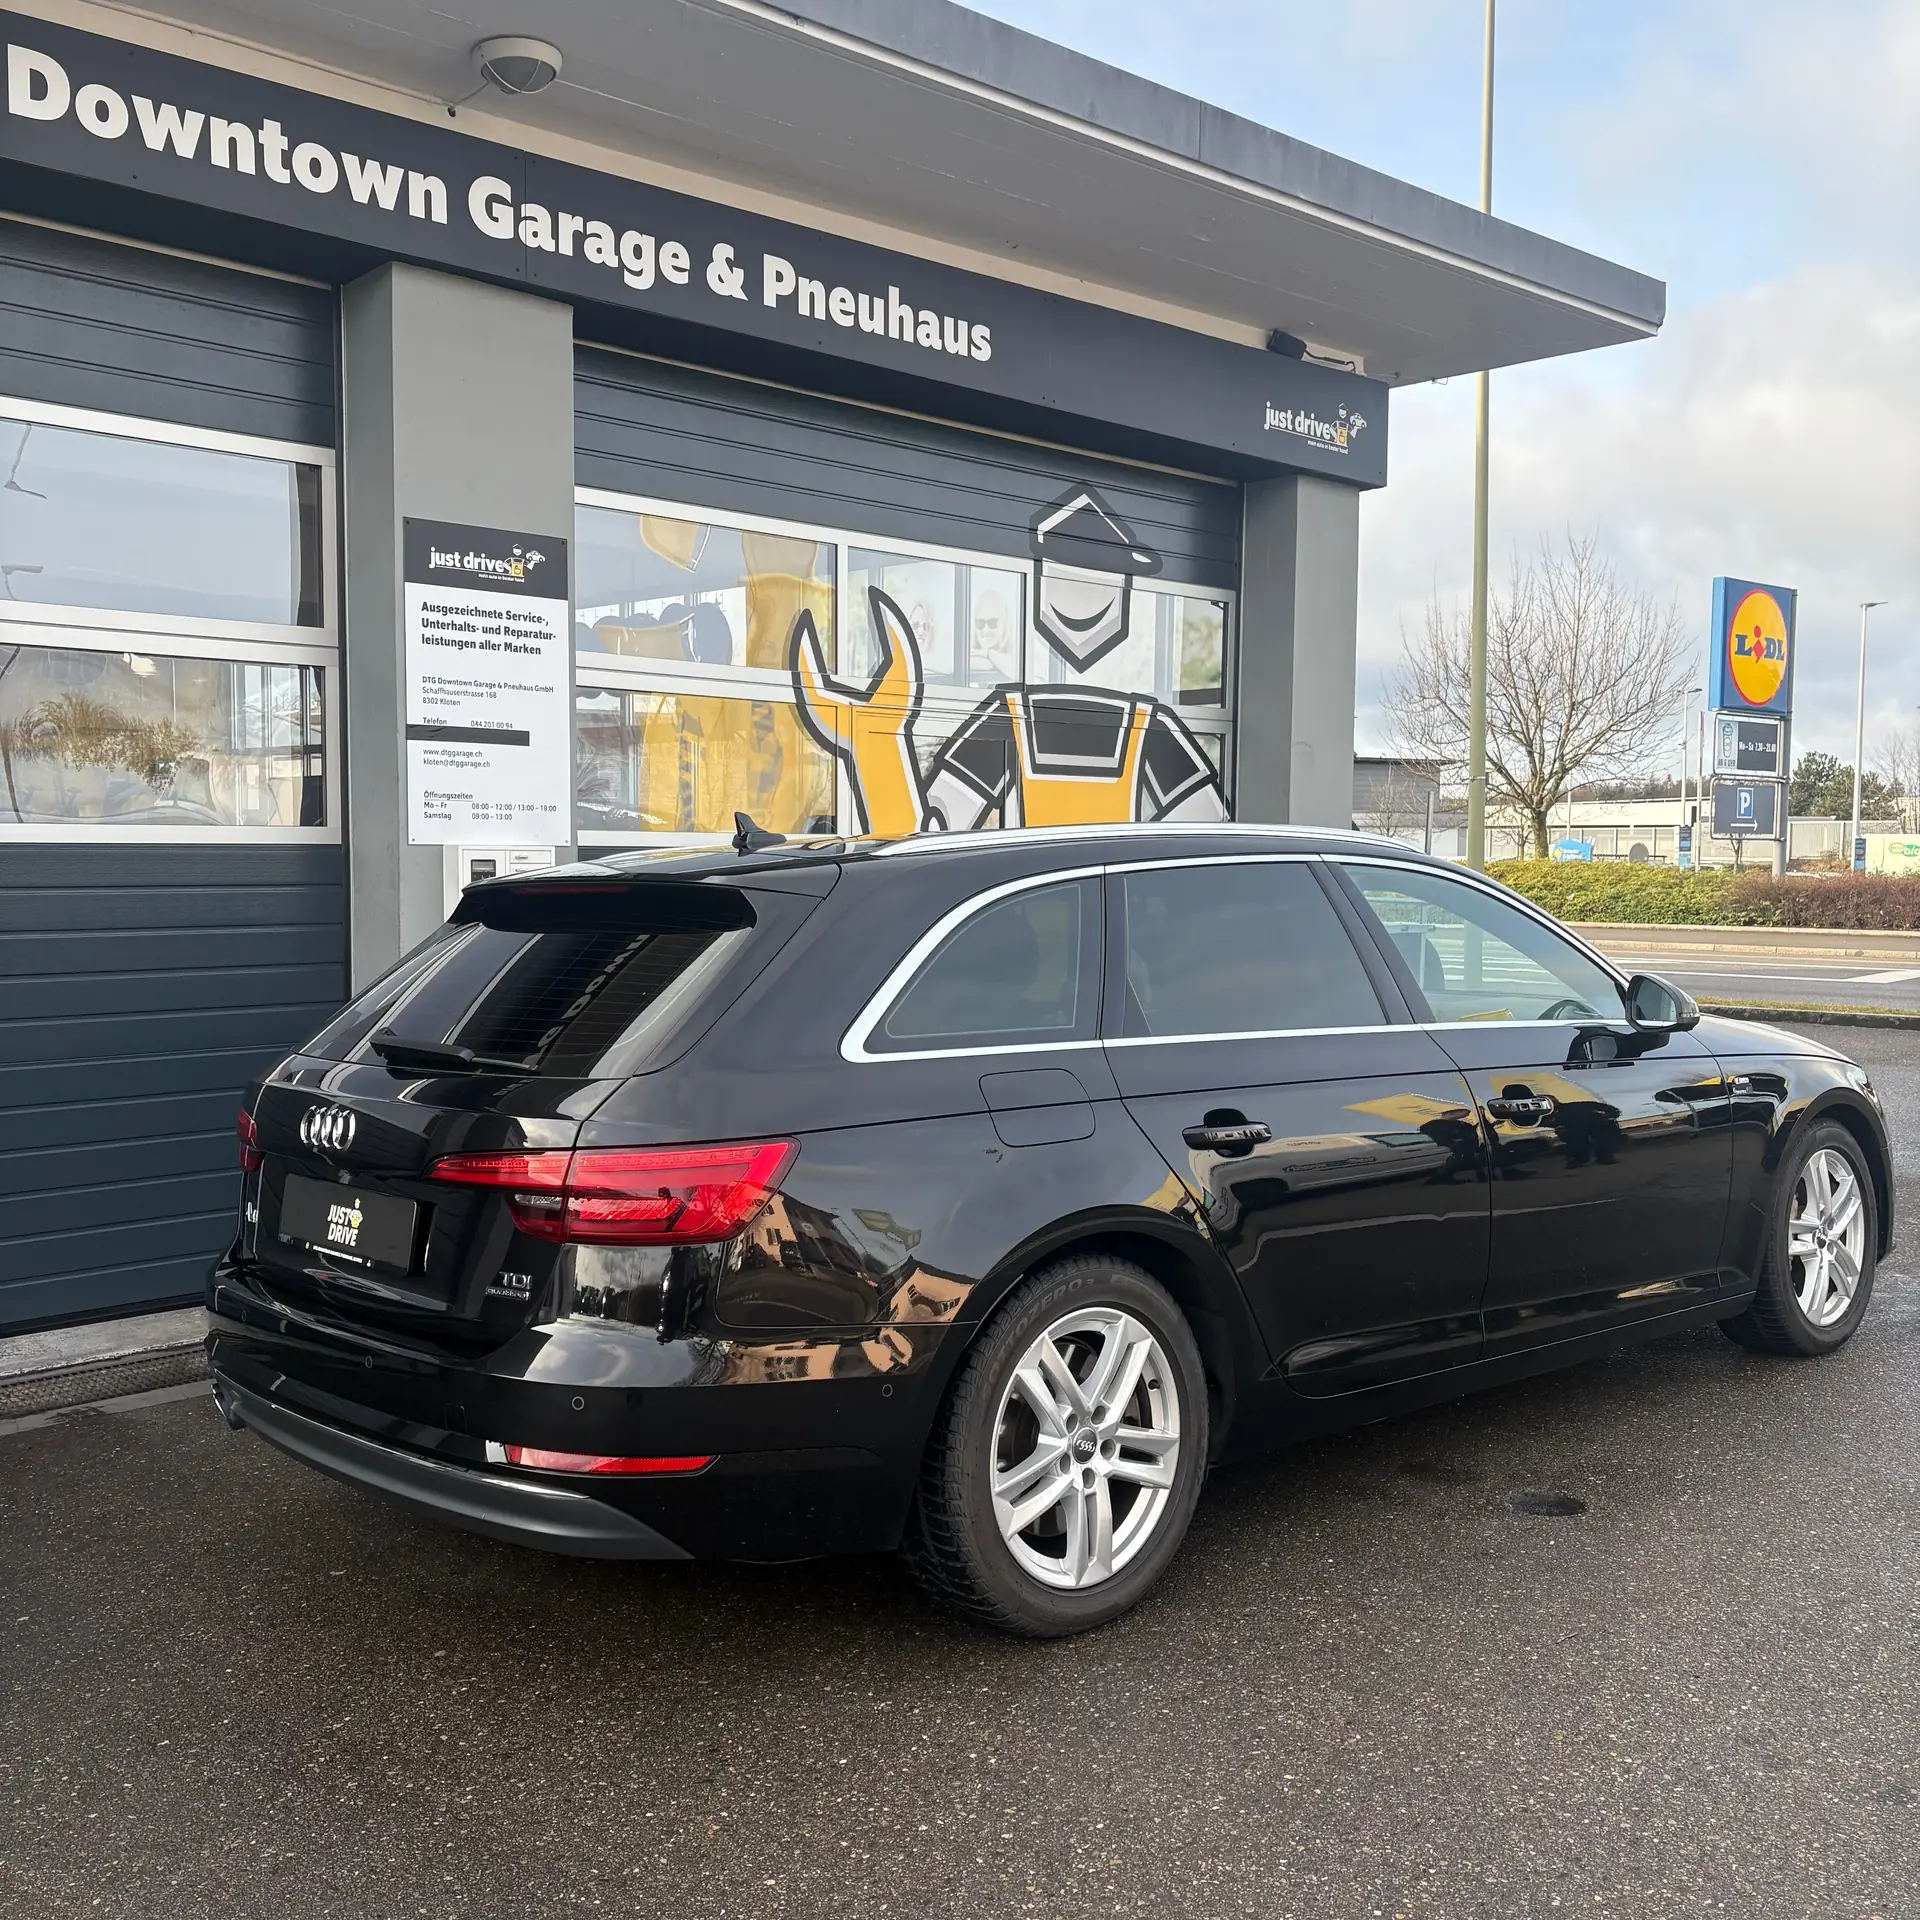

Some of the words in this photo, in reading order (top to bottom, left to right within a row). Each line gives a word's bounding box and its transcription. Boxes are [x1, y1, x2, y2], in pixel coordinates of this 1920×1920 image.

[7, 43, 448, 225] Downtown
[468, 176, 691, 290] Garage
[706, 242, 748, 301] &
[763, 253, 993, 362] Pneuhaus
[1264, 401, 1293, 431] just
[1295, 410, 1331, 440] drive
[429, 546, 461, 569] just
[463, 552, 504, 573] drive
[421, 601, 504, 620] Ausgezeichnete
[505, 610, 549, 626] Service-,
[421, 617, 480, 633] Unterhalts-
[482, 625, 501, 636] und
[503, 626, 557, 640] Reparatur-
[421, 633, 477, 650] leistungen
[478, 640, 502, 651] aller
[504, 642, 541, 655] Marken
[422, 676, 437, 684] DTG
[437, 677, 473, 687] Downtown
[473, 680, 497, 690] Garage
[497, 681, 503, 689] &
[503, 682, 534, 692] Pneuhaus
[534, 684, 554, 693] GmbH
[422, 686, 485, 698] Schaffhauserstrasse
[485, 691, 497, 699] 168
[422, 697, 439, 705] 8302
[439, 698, 461, 706] Kloten
[422, 717, 448, 725] Telefon
[496, 721, 504, 729] 00
[422, 749, 483, 758] www.dtggarage.ch
[423, 758, 491, 769] kloten@dtggarage.ch
[423, 789, 473, 800] Öffnungszeiten
[1740, 789, 1750, 814] P
[423, 812, 452, 820] Samstag
[471, 812, 489, 820] 09:00
[495, 803, 513, 811] 12:00
[327, 1204, 351, 1226] JUST
[327, 1223, 359, 1247] DRIVE
[499, 1271, 532, 1290] TDI
